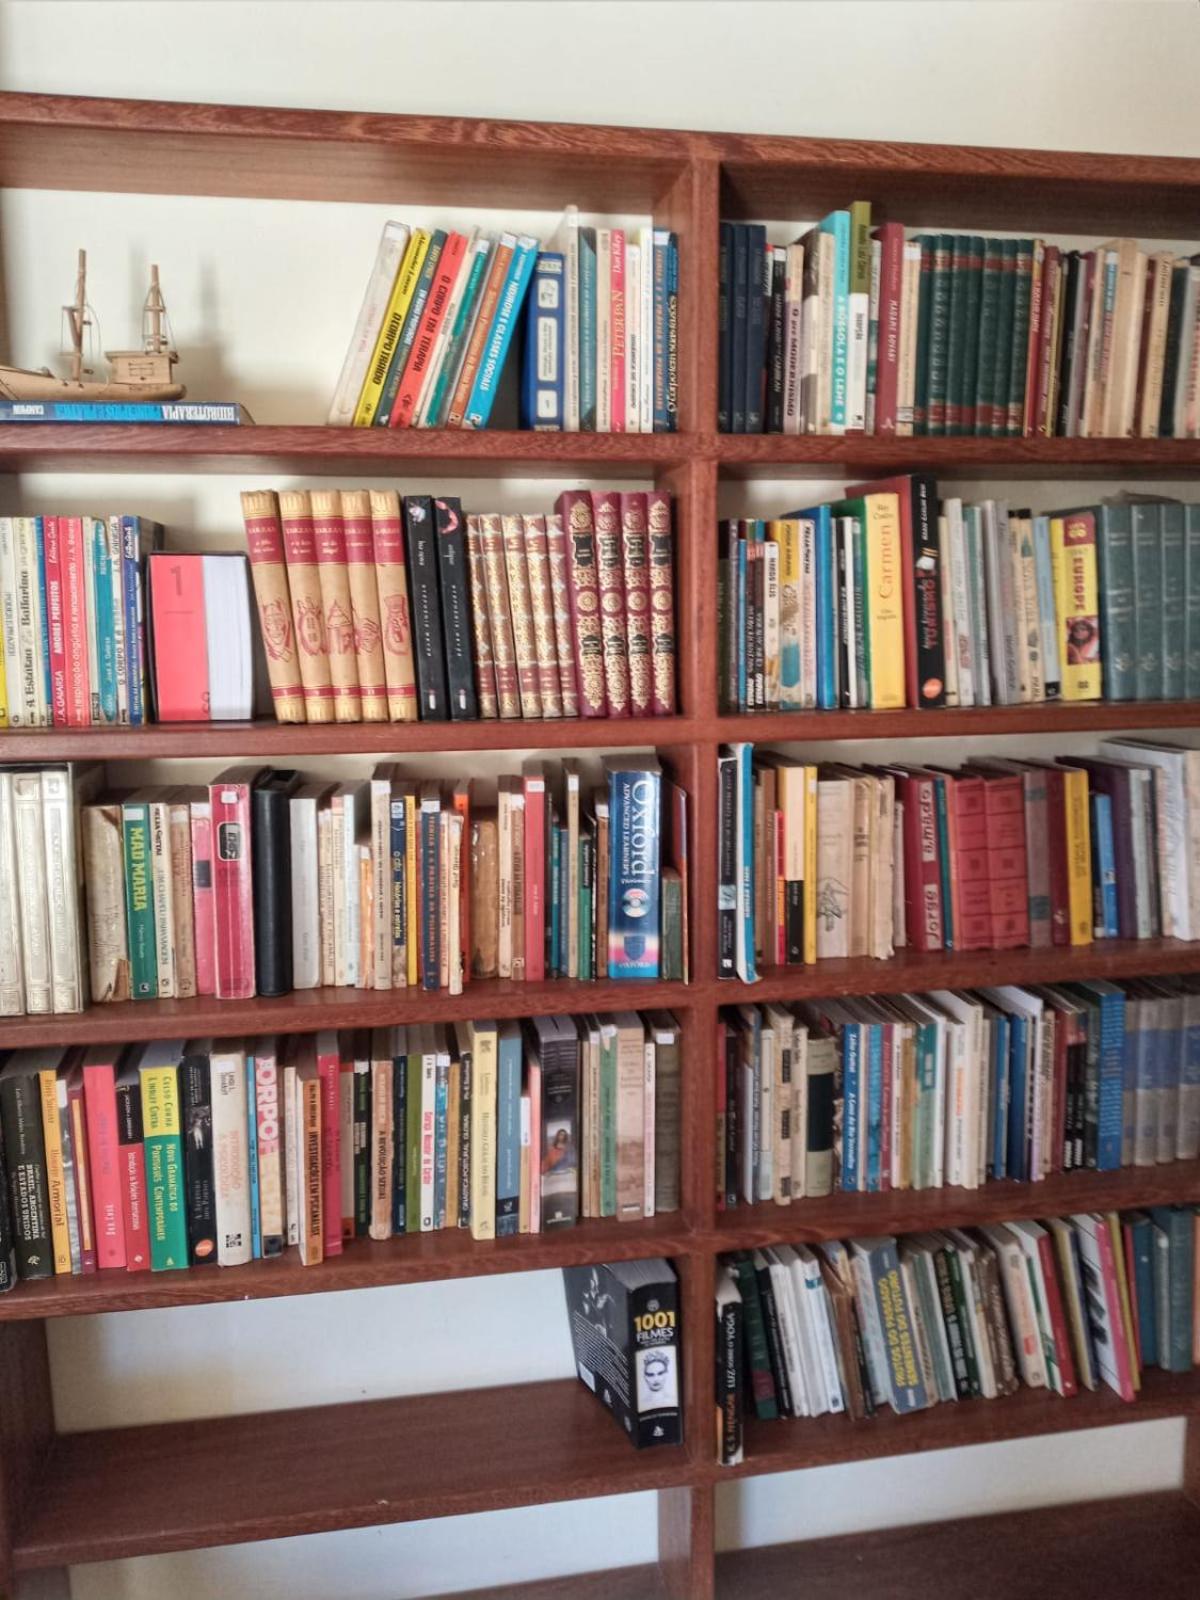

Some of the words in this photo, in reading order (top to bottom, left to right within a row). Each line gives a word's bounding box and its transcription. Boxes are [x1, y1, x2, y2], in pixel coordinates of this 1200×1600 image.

[440, 274, 452, 283] O
[431, 284, 449, 315] CORPO
[501, 280, 519, 317] NEUROSE
[391, 312, 402, 321] O
[424, 316, 438, 333] EM
[382, 318, 400, 350] CORPO
[488, 323, 507, 358] CLASSES
[411, 334, 433, 374] TERAPIA
[478, 357, 497, 392] SOCIAIS
[787, 338, 798, 417] MODERNISMO
[836, 379, 845, 406] LEME
[161, 405, 235, 421] HIDROTERAPIA
[877, 524, 893, 600] Carmen
[50, 580, 61, 620] PERFEITOS
[1073, 557, 1086, 611] EUROPE
[52, 622, 62, 654] AMORES
[25, 699, 35, 708] A
[130, 827, 145, 860] MAD
[632, 780, 654, 876] Oxford
[131, 863, 147, 911] MARIA
[148, 1077, 158, 1105] LINDLEY
[163, 1076, 173, 1099] CELSO
[149, 1106, 160, 1129] CINTRA
[164, 1102, 174, 1127] CUNHA
[152, 1145, 163, 1182] PORTUGUÊS
[166, 1144, 177, 1163] NOVA
[307, 1131, 319, 1183] INVESTIGAÇÕES
[377, 1137, 387, 1175] REVOLUÇÃO
[18, 1171, 29, 1209] ESTADOS
[25, 1164, 36, 1193] BRASIL,
[167, 1164, 178, 1201] GRAMÁTICA
[309, 1184, 319, 1194] EM
[379, 1177, 387, 1200] SEXUAL
[28, 1194, 40, 1240] ARGENTINA
[52, 1180, 65, 1226] Armorial
[154, 1186, 166, 1241] CONTEMPORÂNEO
[169, 1202, 179, 1212] DO
[22, 1209, 33, 1241] UNIDOS
[879, 1277, 896, 1329] PASSADO
[888, 1269, 905, 1314] FUTURO
[634, 1311, 676, 1332] 1001
[636, 1327, 674, 1343] FILMES
[727, 1313, 735, 1341] YOGA
[887, 1329, 898, 1346] DO
[895, 1314, 907, 1330] DO
[890, 1346, 906, 1387] FRUTOS
[899, 1330, 918, 1387] SEMENTES
[727, 1369, 735, 1388] LUZ
